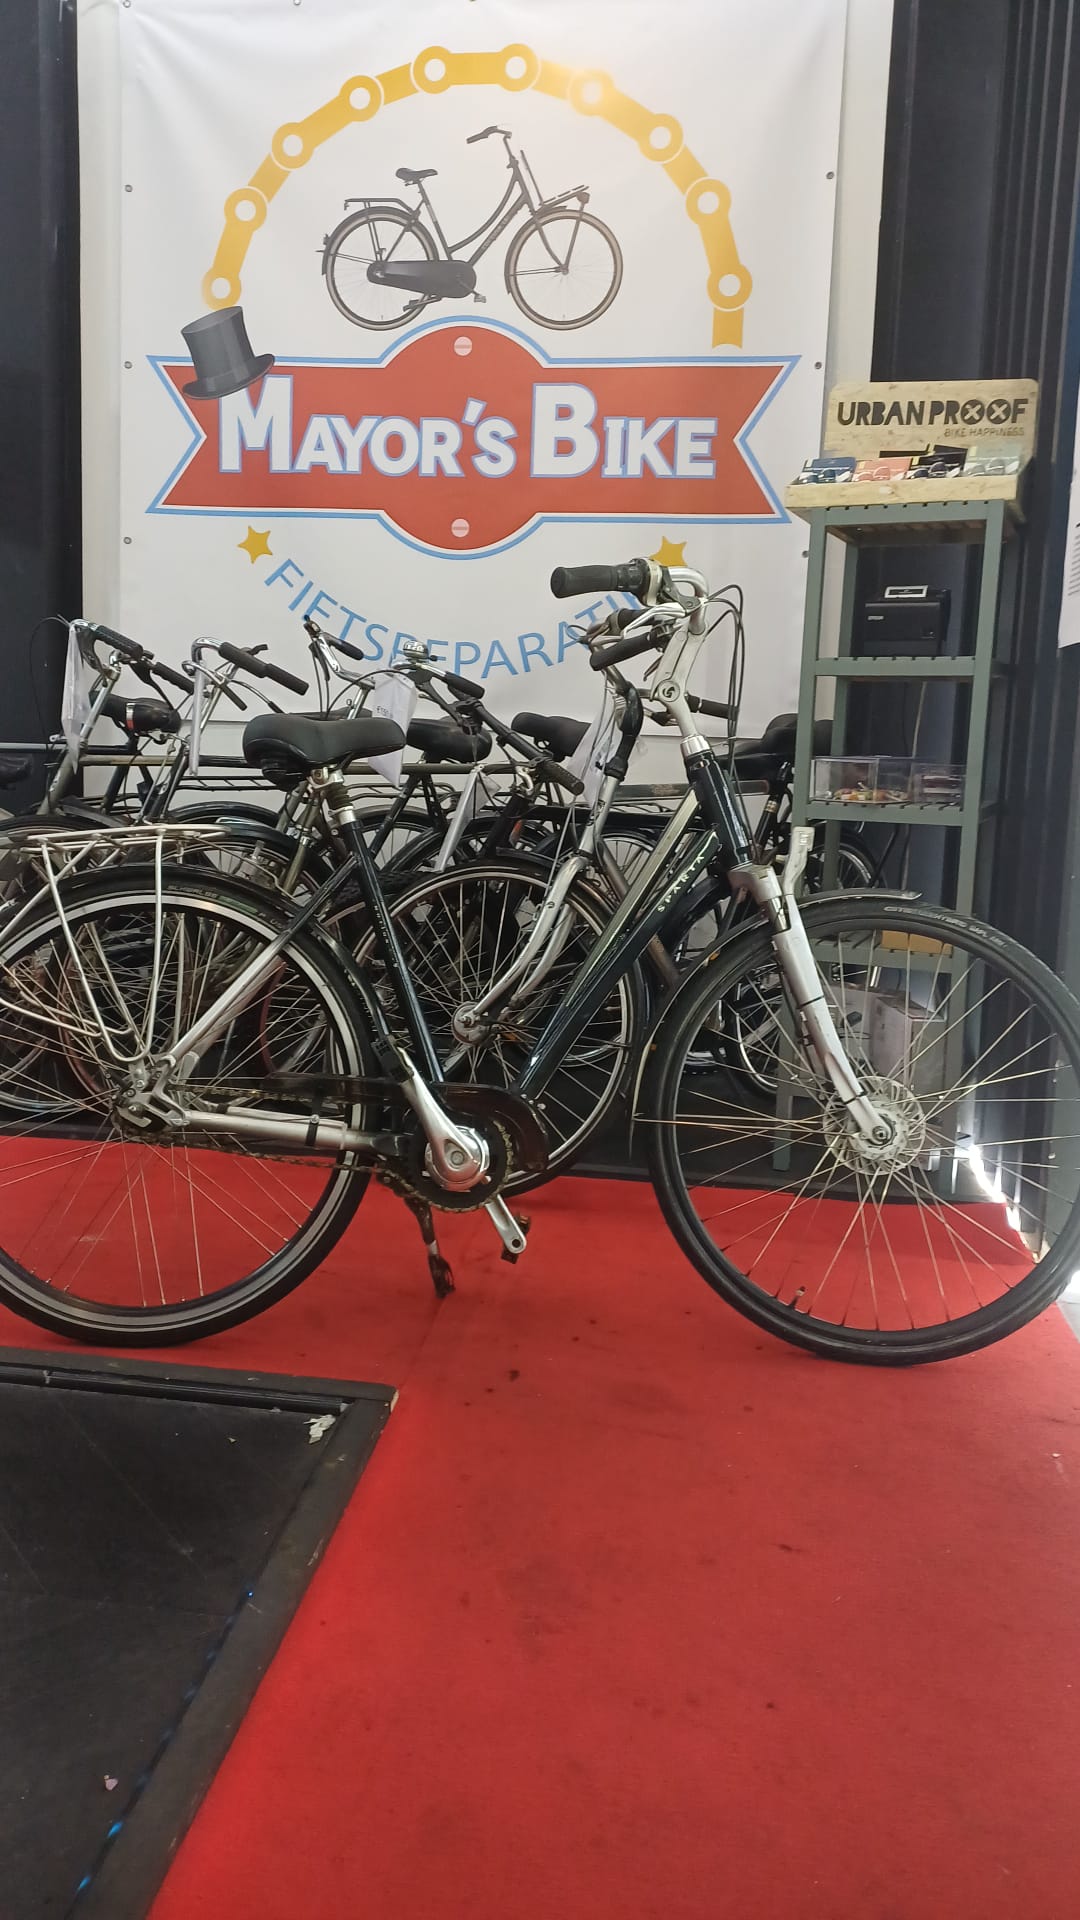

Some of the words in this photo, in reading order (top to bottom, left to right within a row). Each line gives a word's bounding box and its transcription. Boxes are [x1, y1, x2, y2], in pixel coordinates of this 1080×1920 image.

[219, 375, 518, 478] MAYOR'S
[530, 382, 718, 479] BIKE
[837, 400, 926, 426] URBAN
[928, 398, 1029, 426] PROOF
[944, 427, 967, 438] BIKE
[969, 426, 1025, 437] HAPPINESS
[264, 558, 642, 679] FIETSREPARATI
[656, 854, 704, 913] SPARTA
